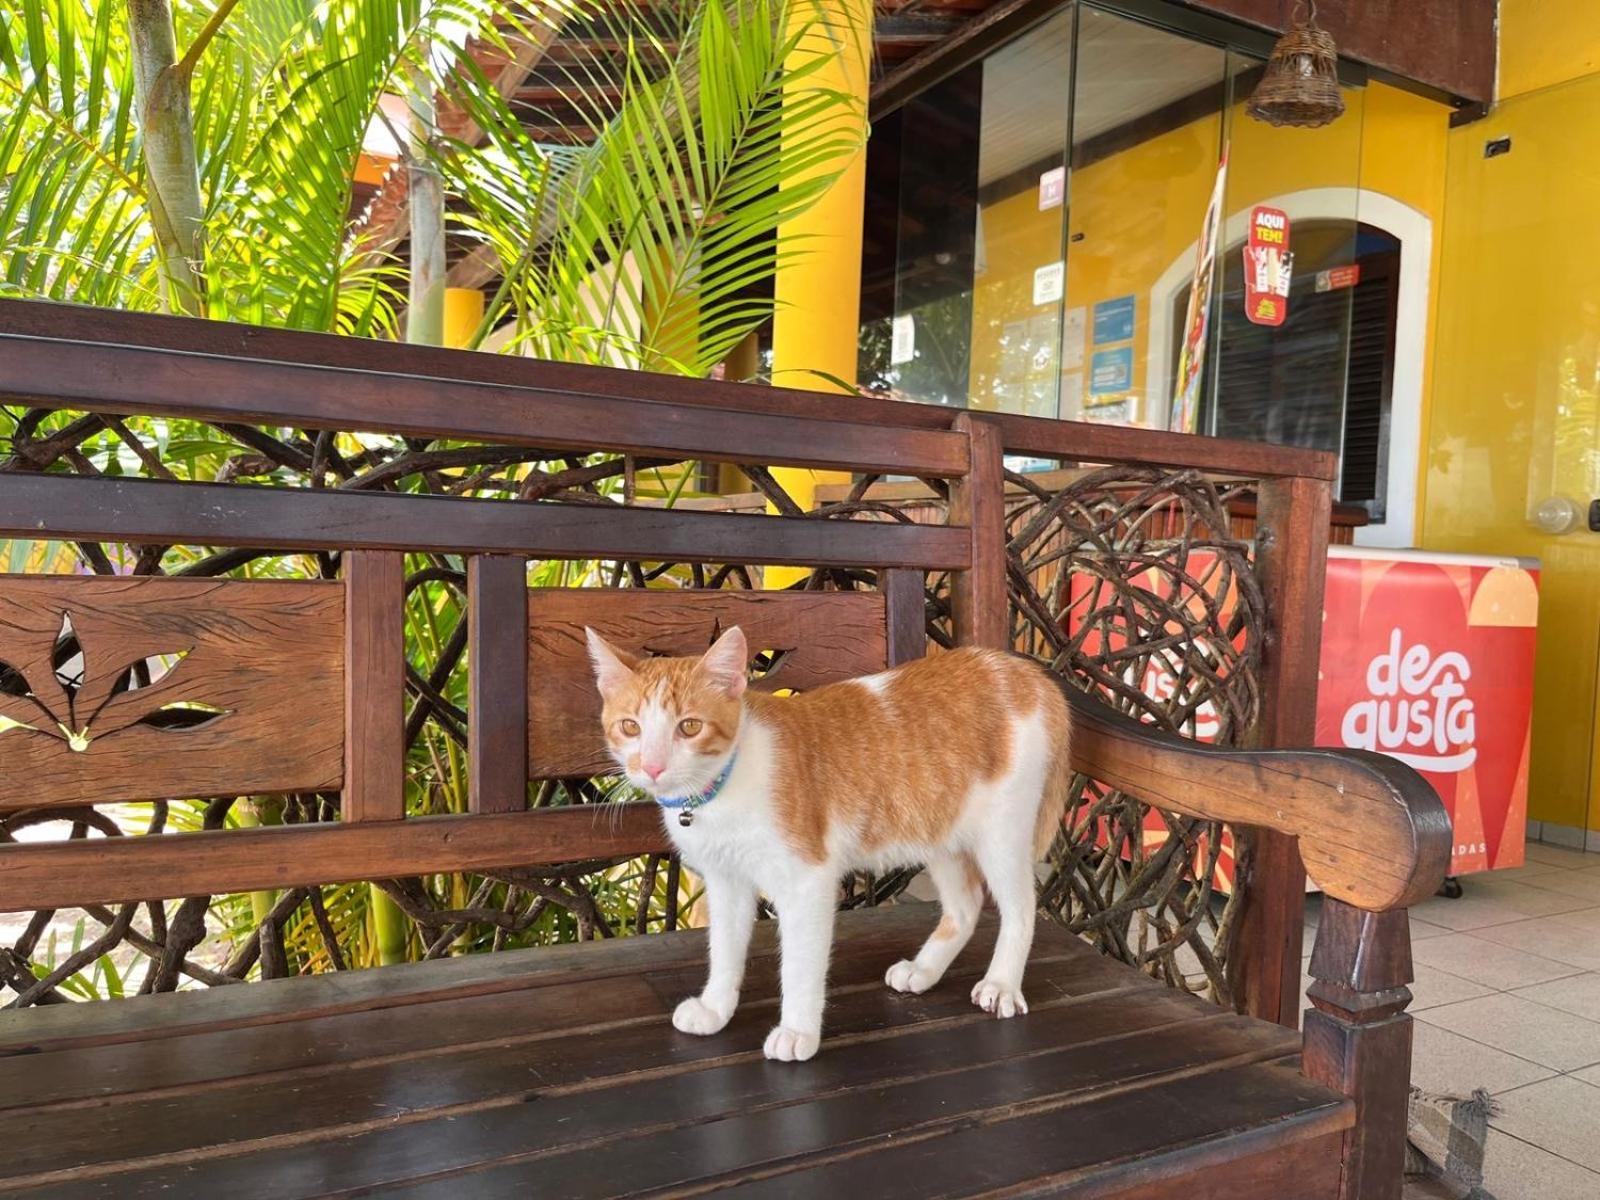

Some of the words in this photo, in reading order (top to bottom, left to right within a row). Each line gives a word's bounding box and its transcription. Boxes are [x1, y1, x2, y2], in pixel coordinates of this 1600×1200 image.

[1256, 212, 1285, 230] AQUI
[1256, 226, 1284, 244] TEM!
[1366, 627, 1471, 696] de
